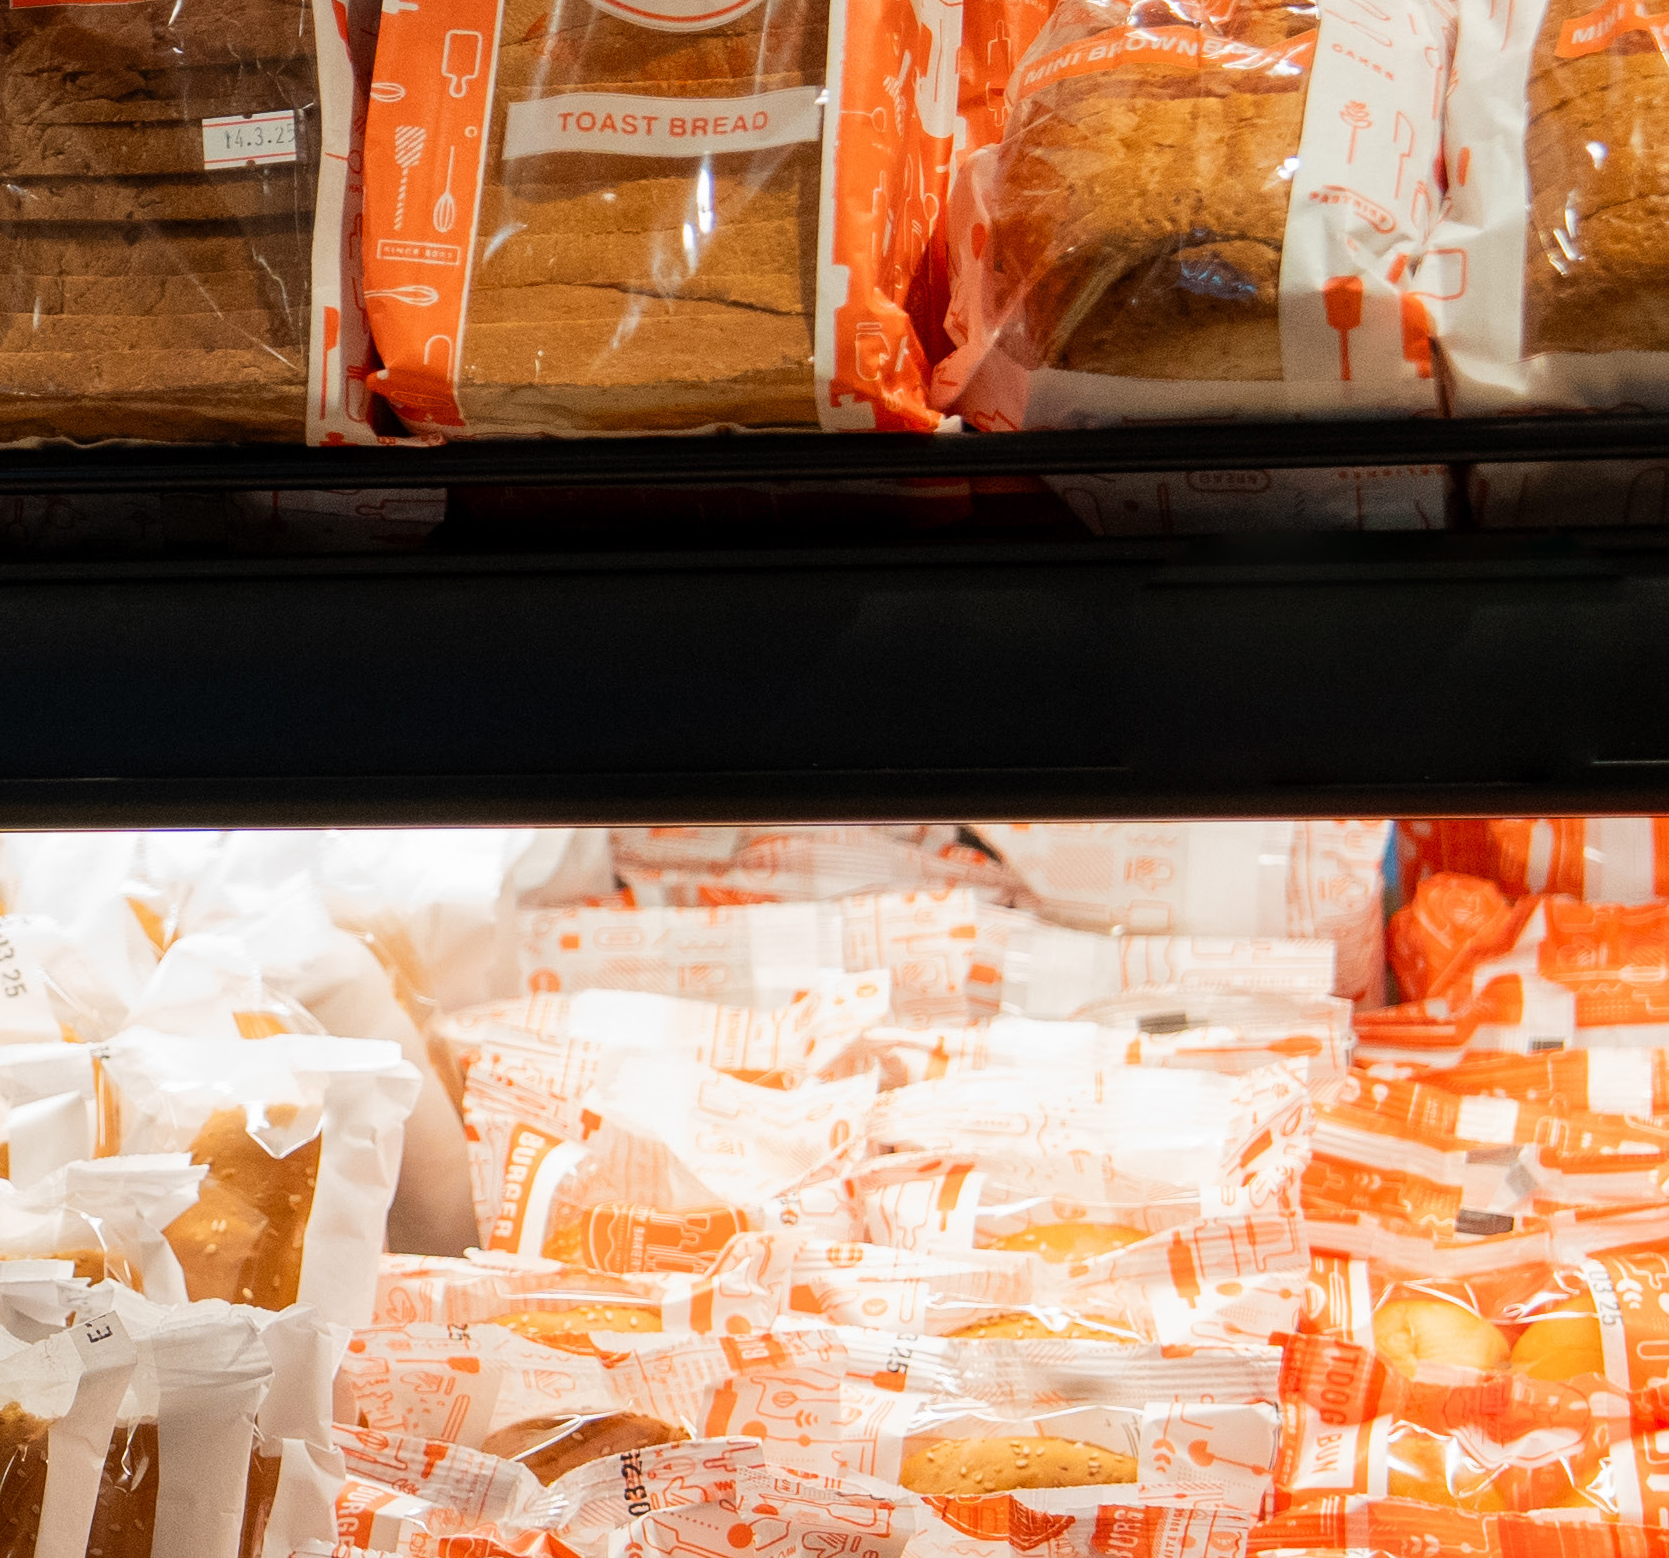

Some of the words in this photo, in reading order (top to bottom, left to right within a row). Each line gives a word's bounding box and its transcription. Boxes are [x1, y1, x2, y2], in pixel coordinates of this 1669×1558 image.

[1023, 52, 1081, 86] MINI
[1088, 37, 1199, 63] BROWN
[223, 123, 296, 150] 14.3.25
[557, 111, 659, 136] TOAST
[669, 110, 770, 138] BREAD
[2, 969, 26, 999] 25
[1600, 1297, 1623, 1327] 25
